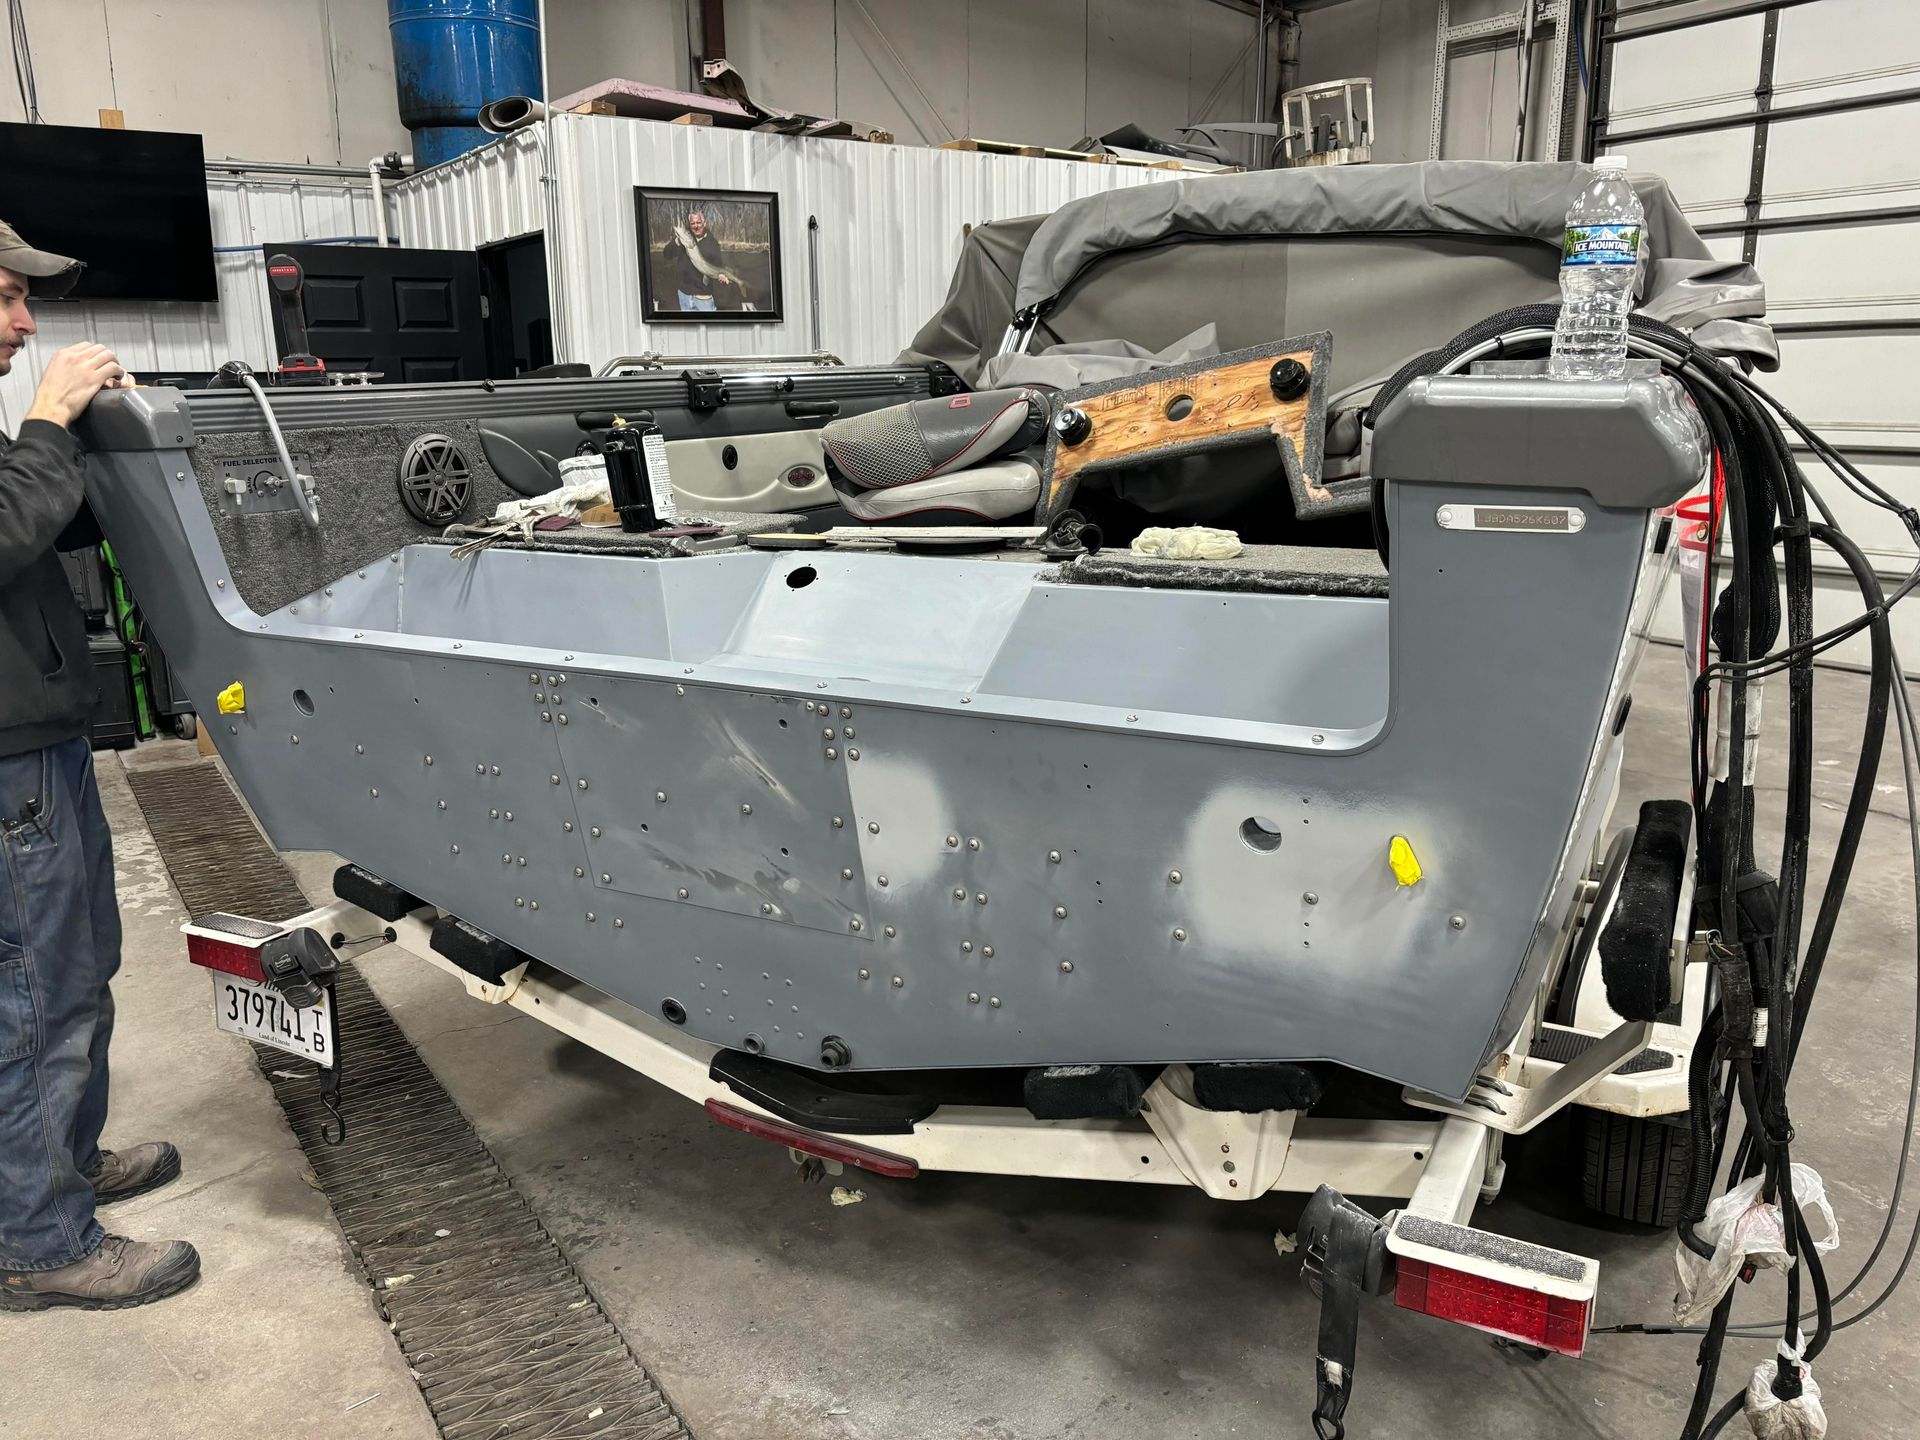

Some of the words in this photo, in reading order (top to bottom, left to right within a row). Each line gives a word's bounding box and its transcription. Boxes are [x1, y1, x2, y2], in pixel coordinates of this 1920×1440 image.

[1575, 242, 1588, 252] ICE
[1588, 241, 1629, 253] MOUNTAIN
[243, 457, 278, 466] SELECTOR
[225, 984, 306, 1043] 379741
[311, 1009, 323, 1031] T
[258, 1032, 269, 1041] Land
[313, 1032, 325, 1053] B
